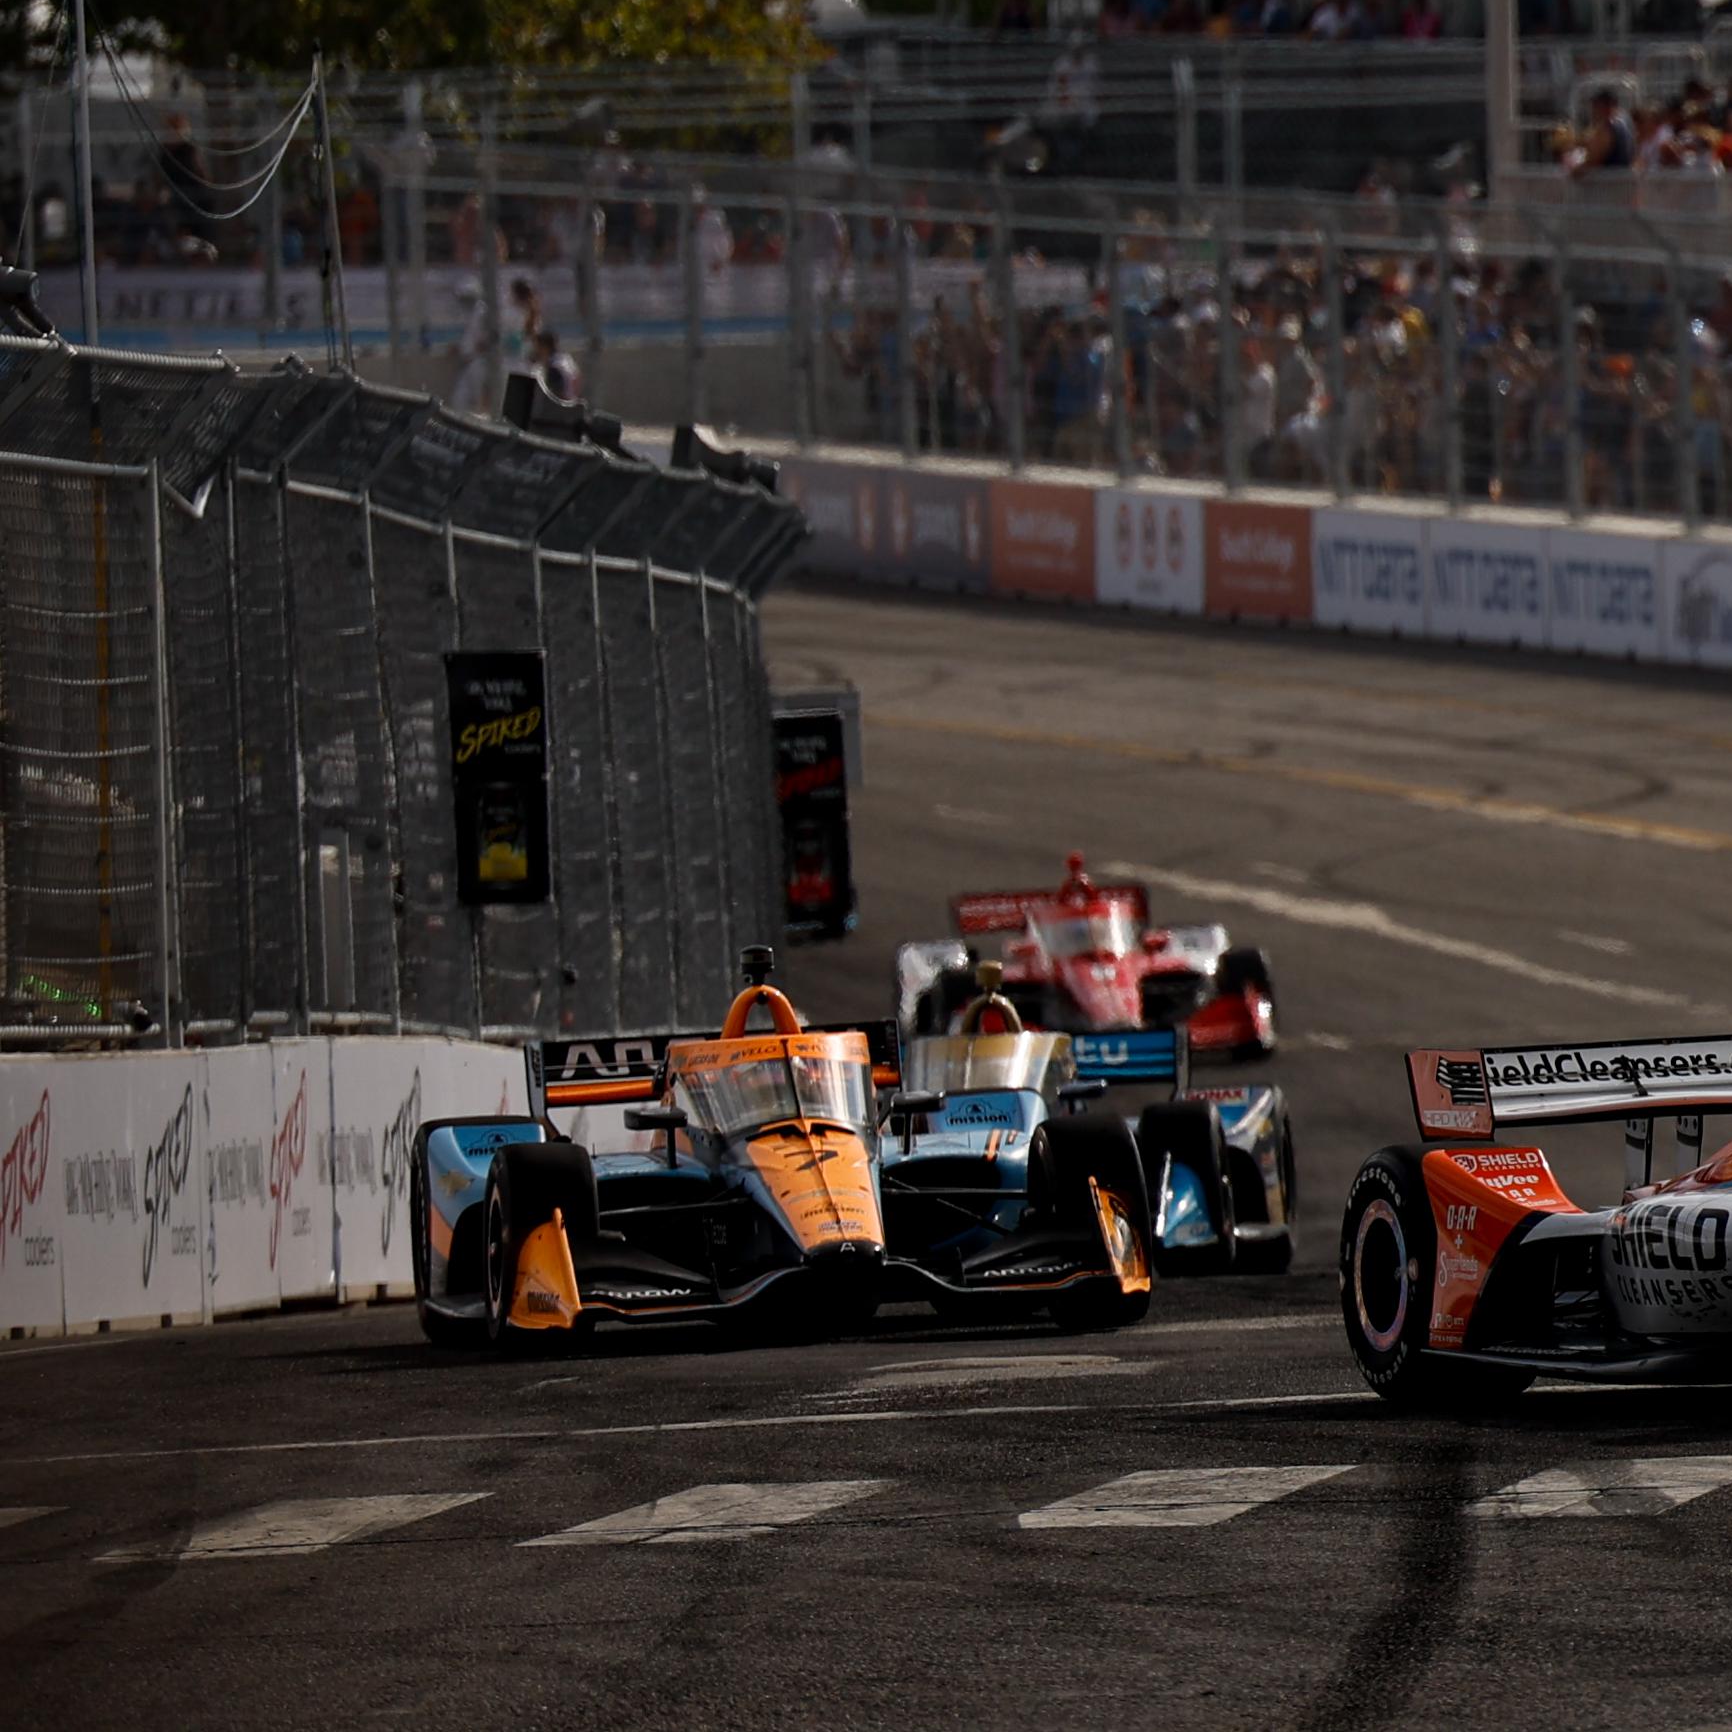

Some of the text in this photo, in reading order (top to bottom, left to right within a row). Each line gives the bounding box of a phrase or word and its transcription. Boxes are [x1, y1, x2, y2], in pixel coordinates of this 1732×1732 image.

[456, 706, 541, 764] SPIKED
[946, 1111, 1009, 1125] mission
[1477, 1152, 1539, 1166] SHIELD
[589, 1288, 691, 1300] ARROW
